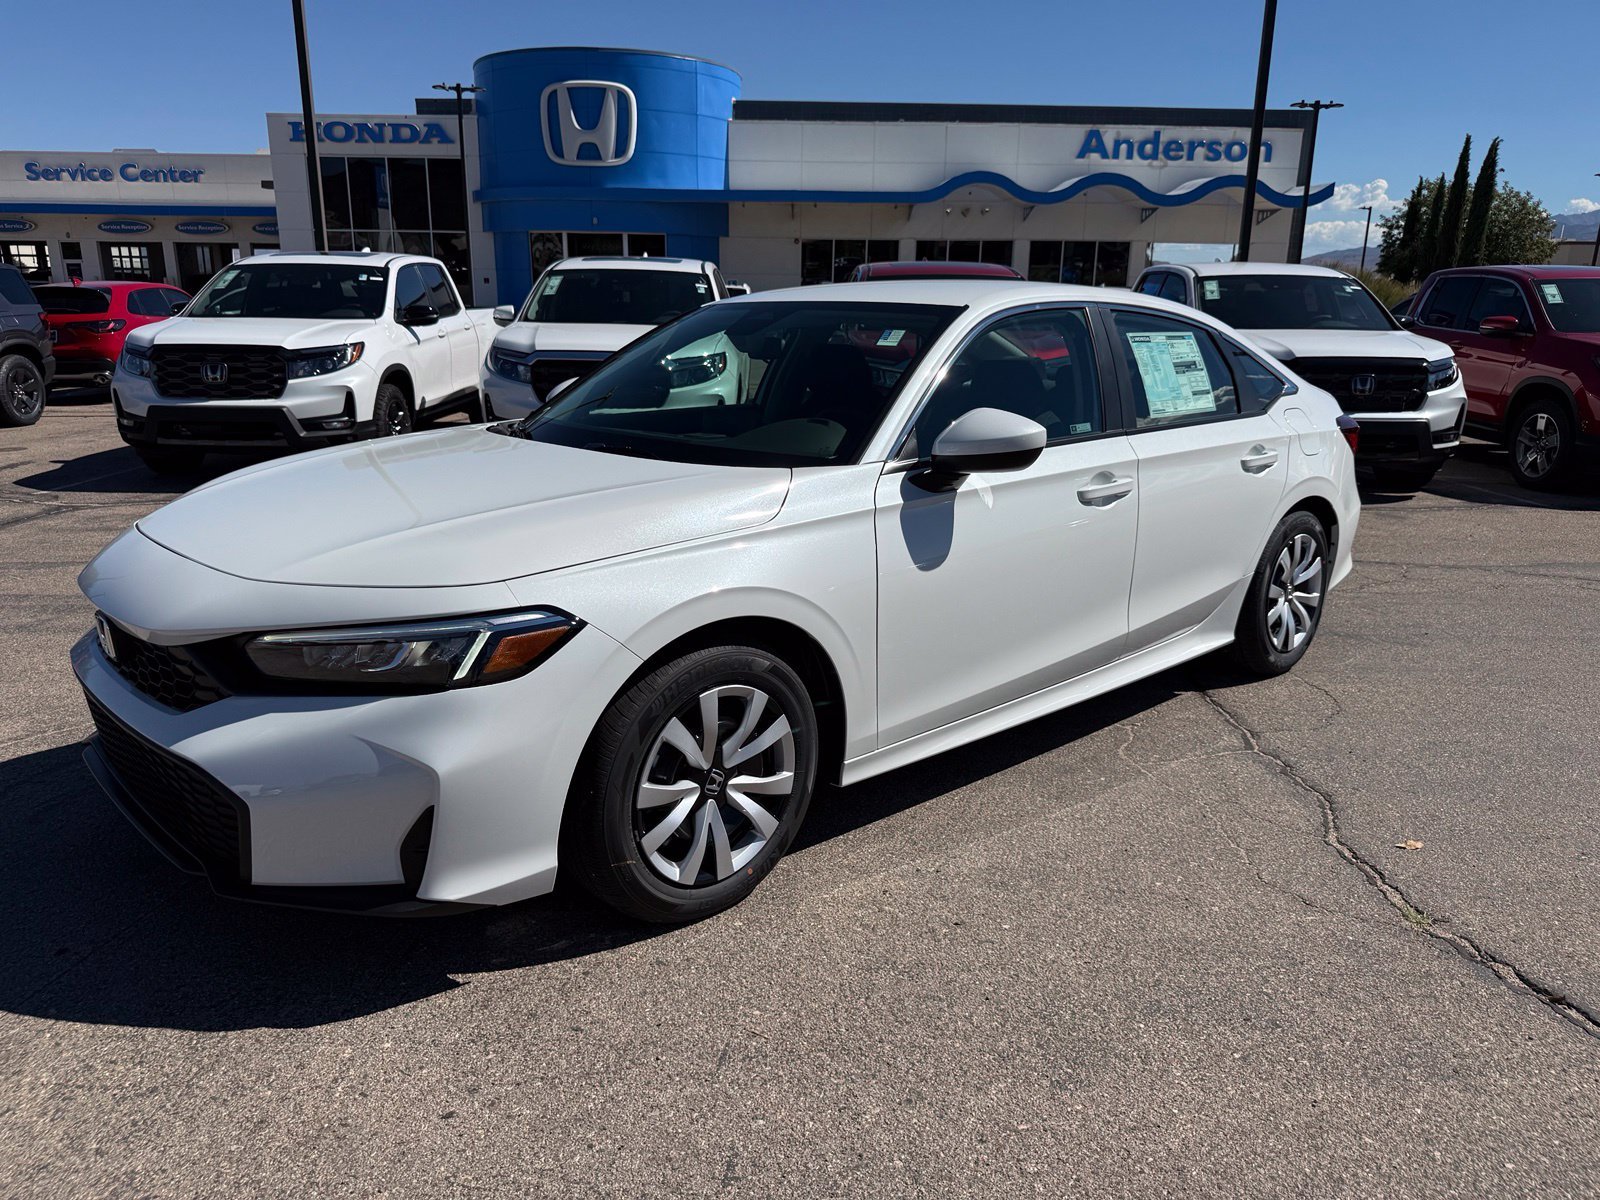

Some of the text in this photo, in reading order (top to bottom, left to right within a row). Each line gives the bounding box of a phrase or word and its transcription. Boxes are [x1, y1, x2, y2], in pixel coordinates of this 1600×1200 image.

[287, 120, 455, 145] HONDA
[24, 161, 205, 184] Service Center
